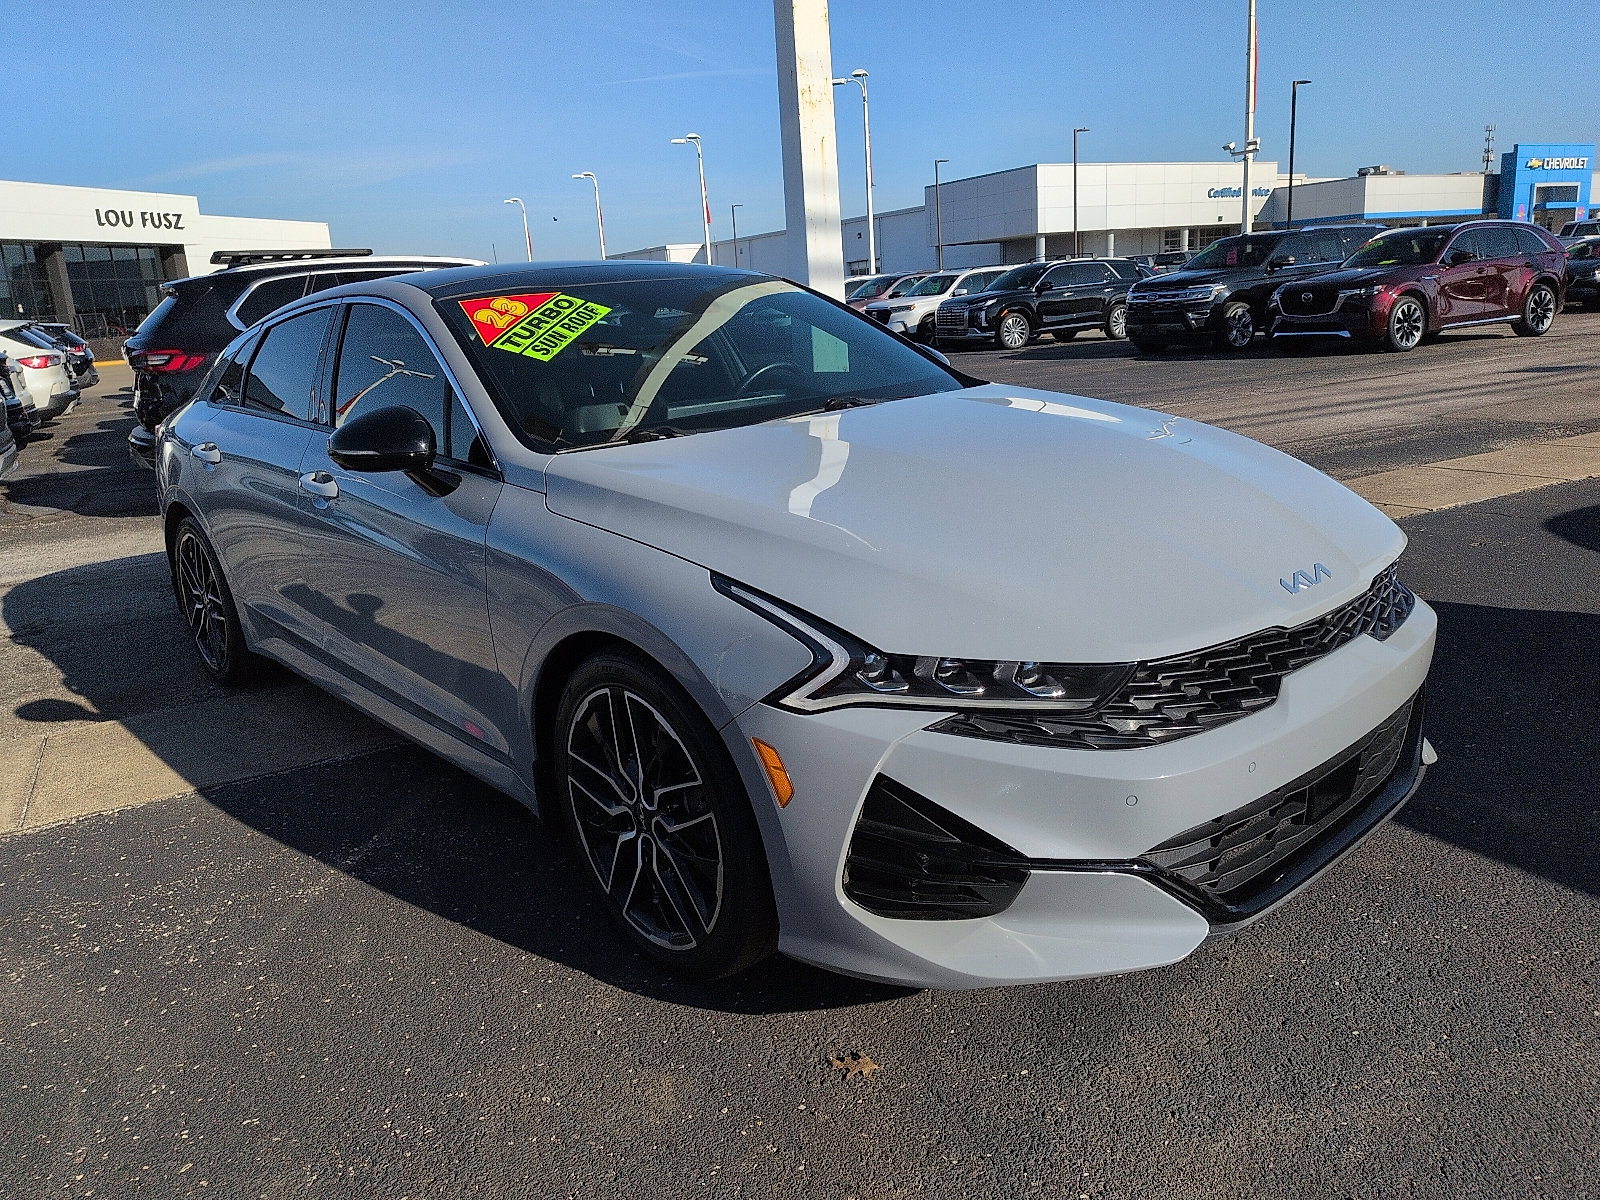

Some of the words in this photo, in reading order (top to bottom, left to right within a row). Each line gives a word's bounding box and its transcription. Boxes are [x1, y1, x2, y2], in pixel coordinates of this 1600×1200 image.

[1543, 157, 1588, 169] CHEVROLET
[95, 208, 134, 228] LOU
[140, 211, 185, 230] FUSZ
[473, 297, 529, 329] 23
[500, 298, 577, 348] TURBO
[532, 328, 569, 356] SUN
[563, 304, 600, 333] ROOF
